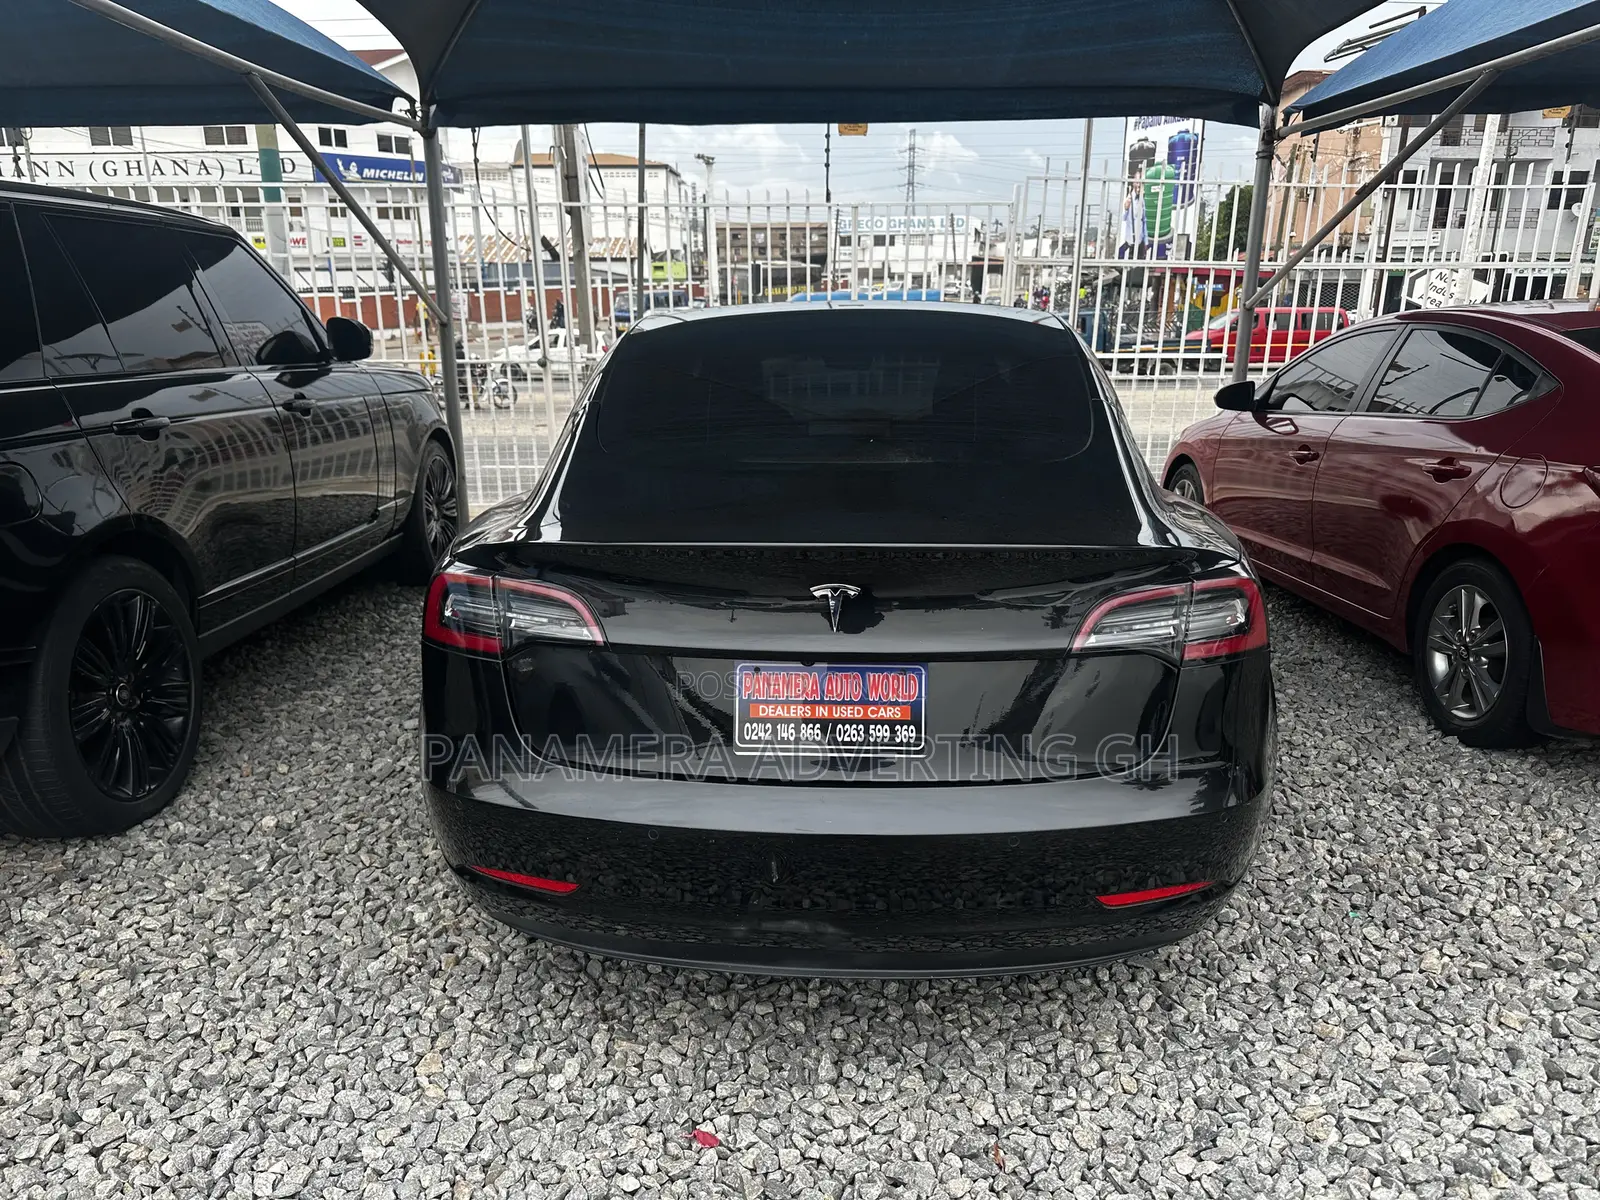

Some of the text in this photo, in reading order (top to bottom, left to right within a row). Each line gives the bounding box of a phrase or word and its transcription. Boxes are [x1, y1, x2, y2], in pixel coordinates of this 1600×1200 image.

[89, 159, 225, 182] (GHANA)
[237, 158, 297, 176] LD
[362, 168, 424, 182] MICHELIN
[889, 218, 936, 229] GHANA
[742, 670, 920, 703] PANAMERA AUTO WORLD
[759, 705, 902, 719] DEALERS IN USED CARS
[743, 722, 772, 741] 0242
[777, 723, 796, 741] 146
[799, 724, 821, 742] 866
[835, 724, 865, 742] 0263
[868, 725, 891, 743] 599
[894, 725, 917, 744] 369
